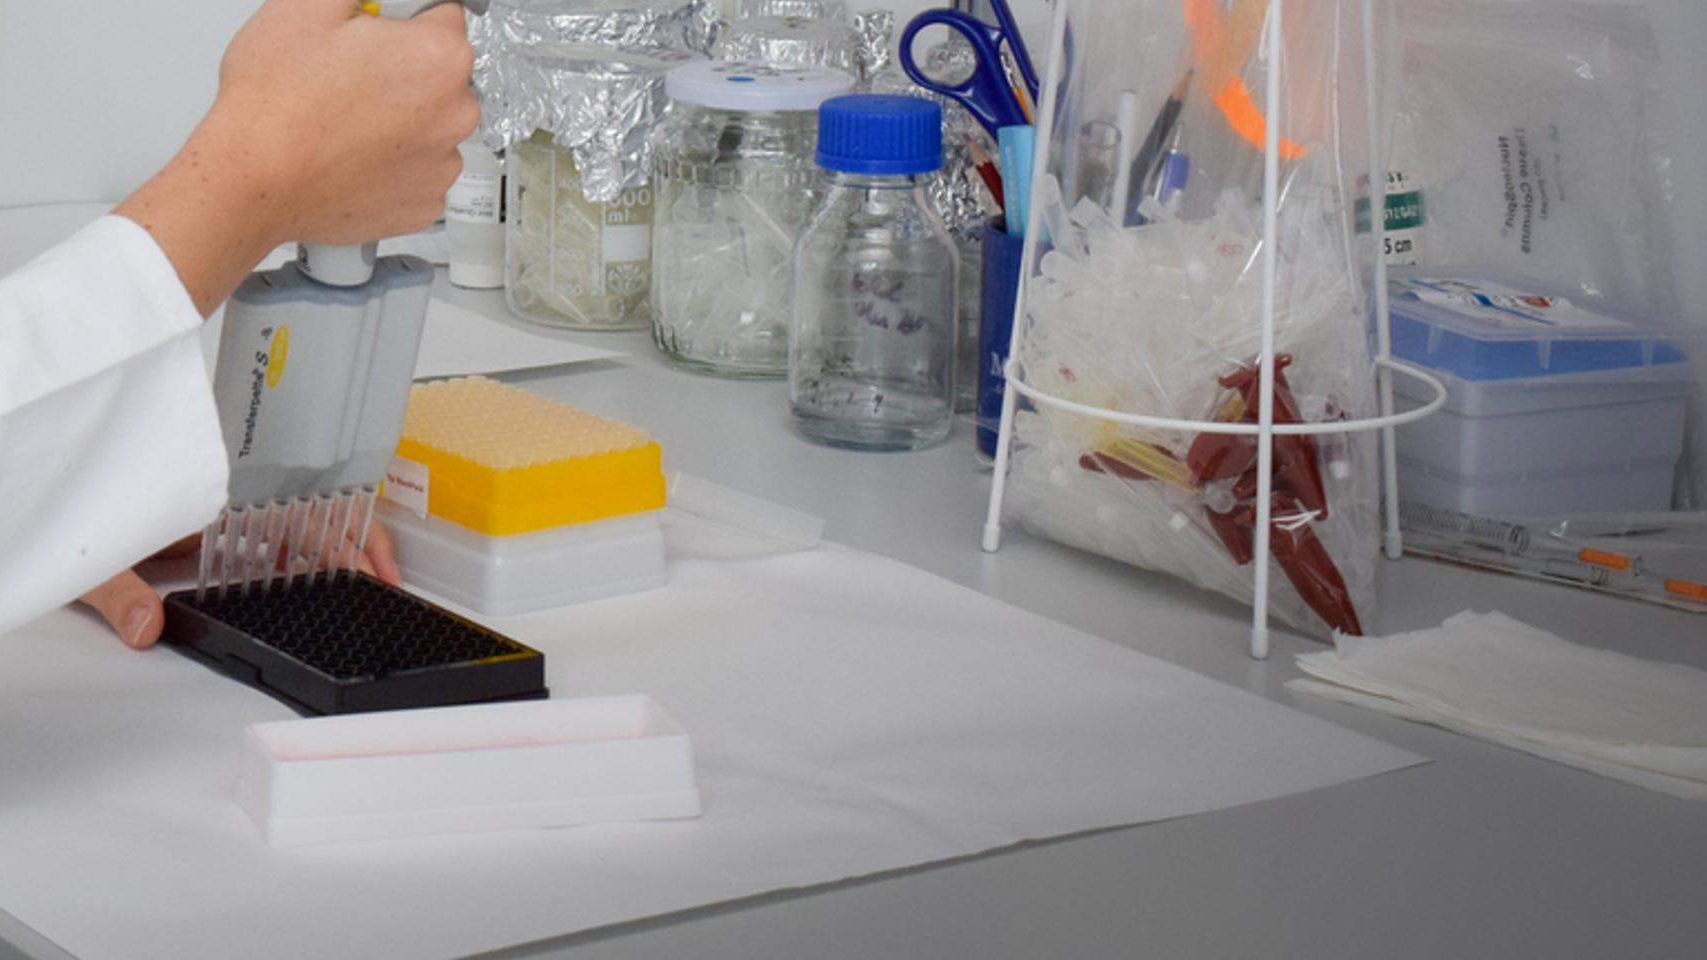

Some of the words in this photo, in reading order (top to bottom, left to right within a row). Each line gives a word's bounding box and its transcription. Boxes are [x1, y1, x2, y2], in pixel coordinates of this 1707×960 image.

[608, 211, 629, 223] ml
[1395, 239, 1412, 253] cm
[255, 351, 269, 366] S
